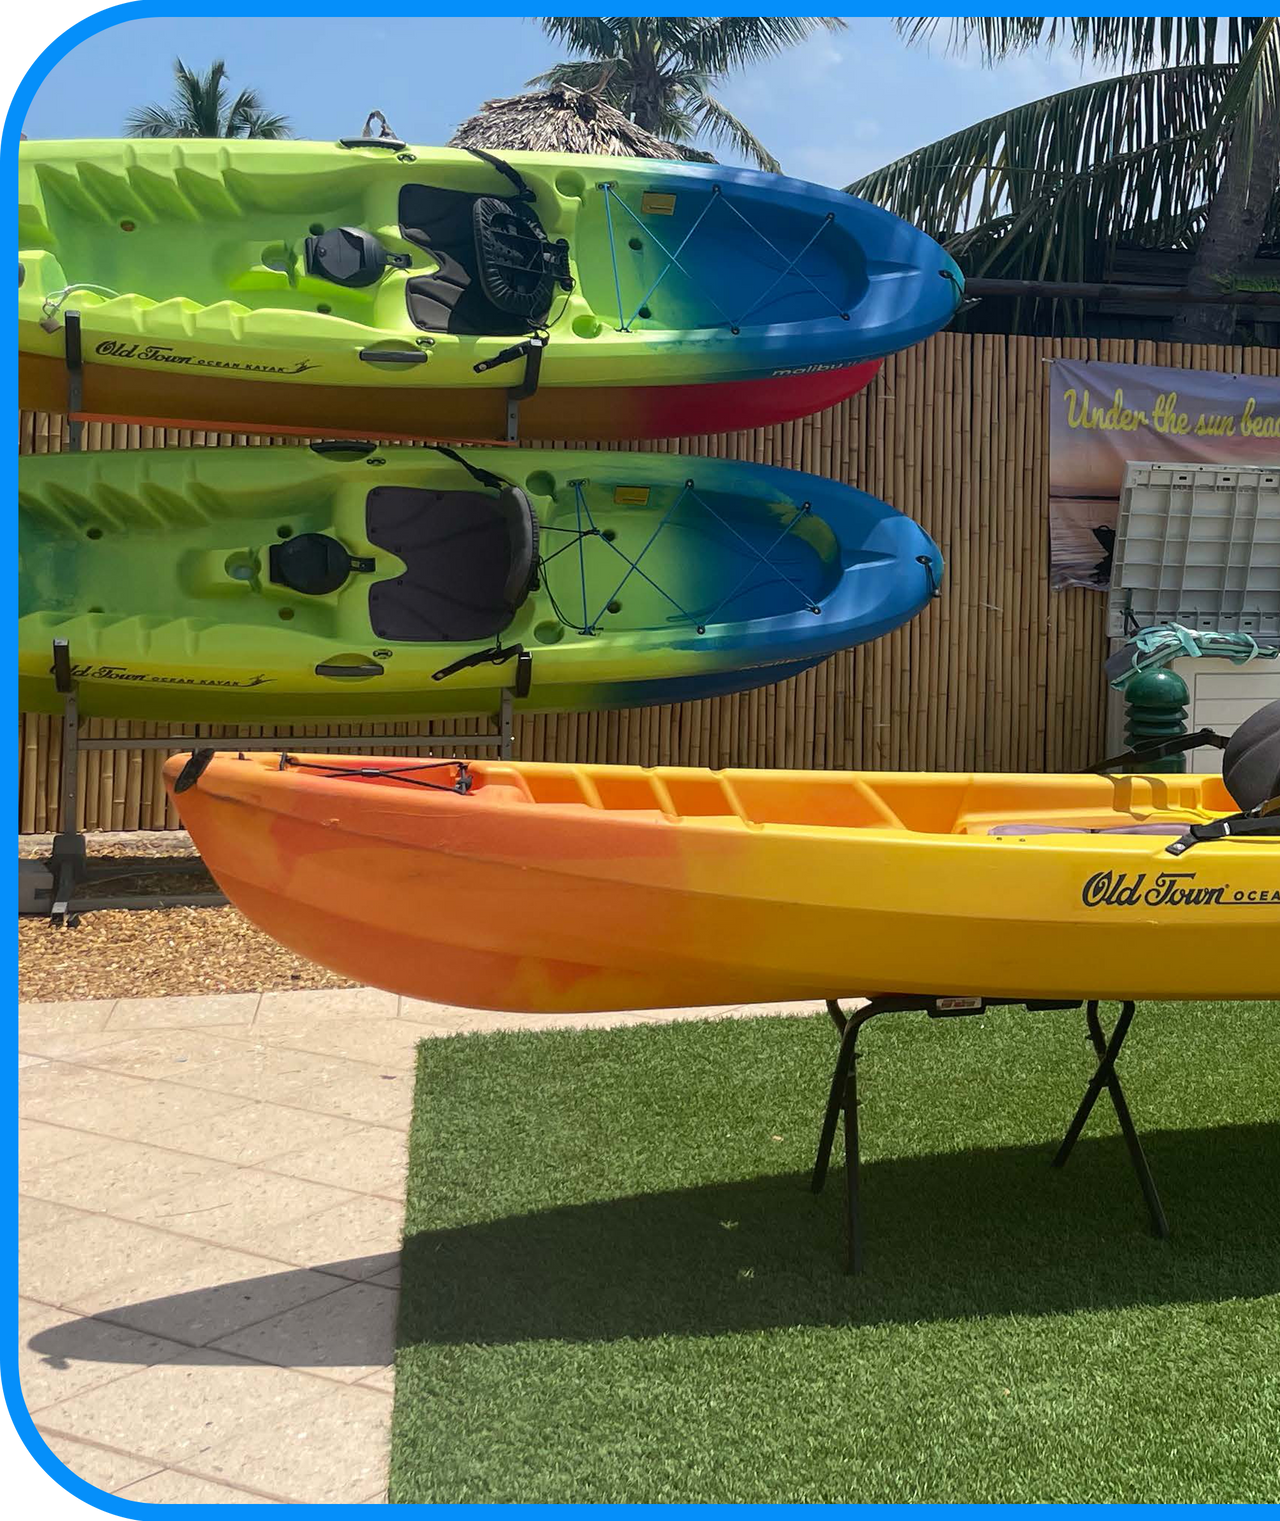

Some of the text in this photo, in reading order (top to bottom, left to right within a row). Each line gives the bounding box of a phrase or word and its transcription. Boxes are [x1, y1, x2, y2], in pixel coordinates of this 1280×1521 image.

[95, 340, 284, 374] Old Town OCEAN KAYAK
[1063, 388, 1149, 432] Under
[1150, 392, 1191, 435] the
[1194, 413, 1236, 438] sun
[90, 666, 146, 681] Town
[1082, 869, 1147, 907] Old
[1144, 872, 1224, 907] Town
